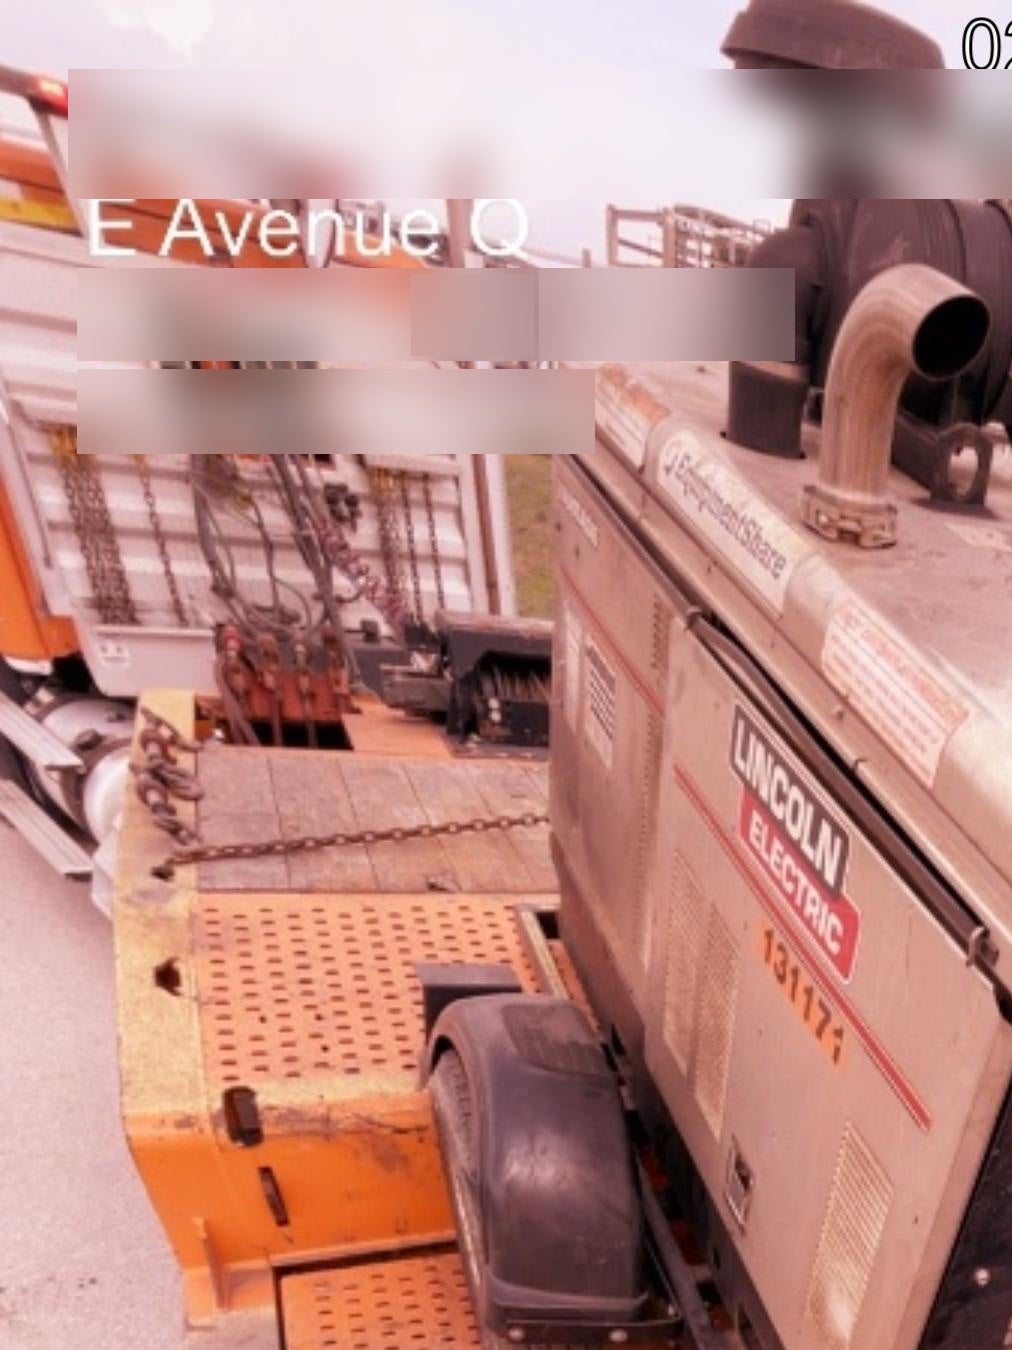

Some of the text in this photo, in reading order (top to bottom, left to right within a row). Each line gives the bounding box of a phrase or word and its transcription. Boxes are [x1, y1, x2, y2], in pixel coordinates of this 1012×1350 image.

[677, 452, 787, 580] EquipmentShare
[733, 718, 844, 889] LINCOLN
[748, 808, 845, 956] ELECTRIC
[760, 927, 845, 1066] 131171
